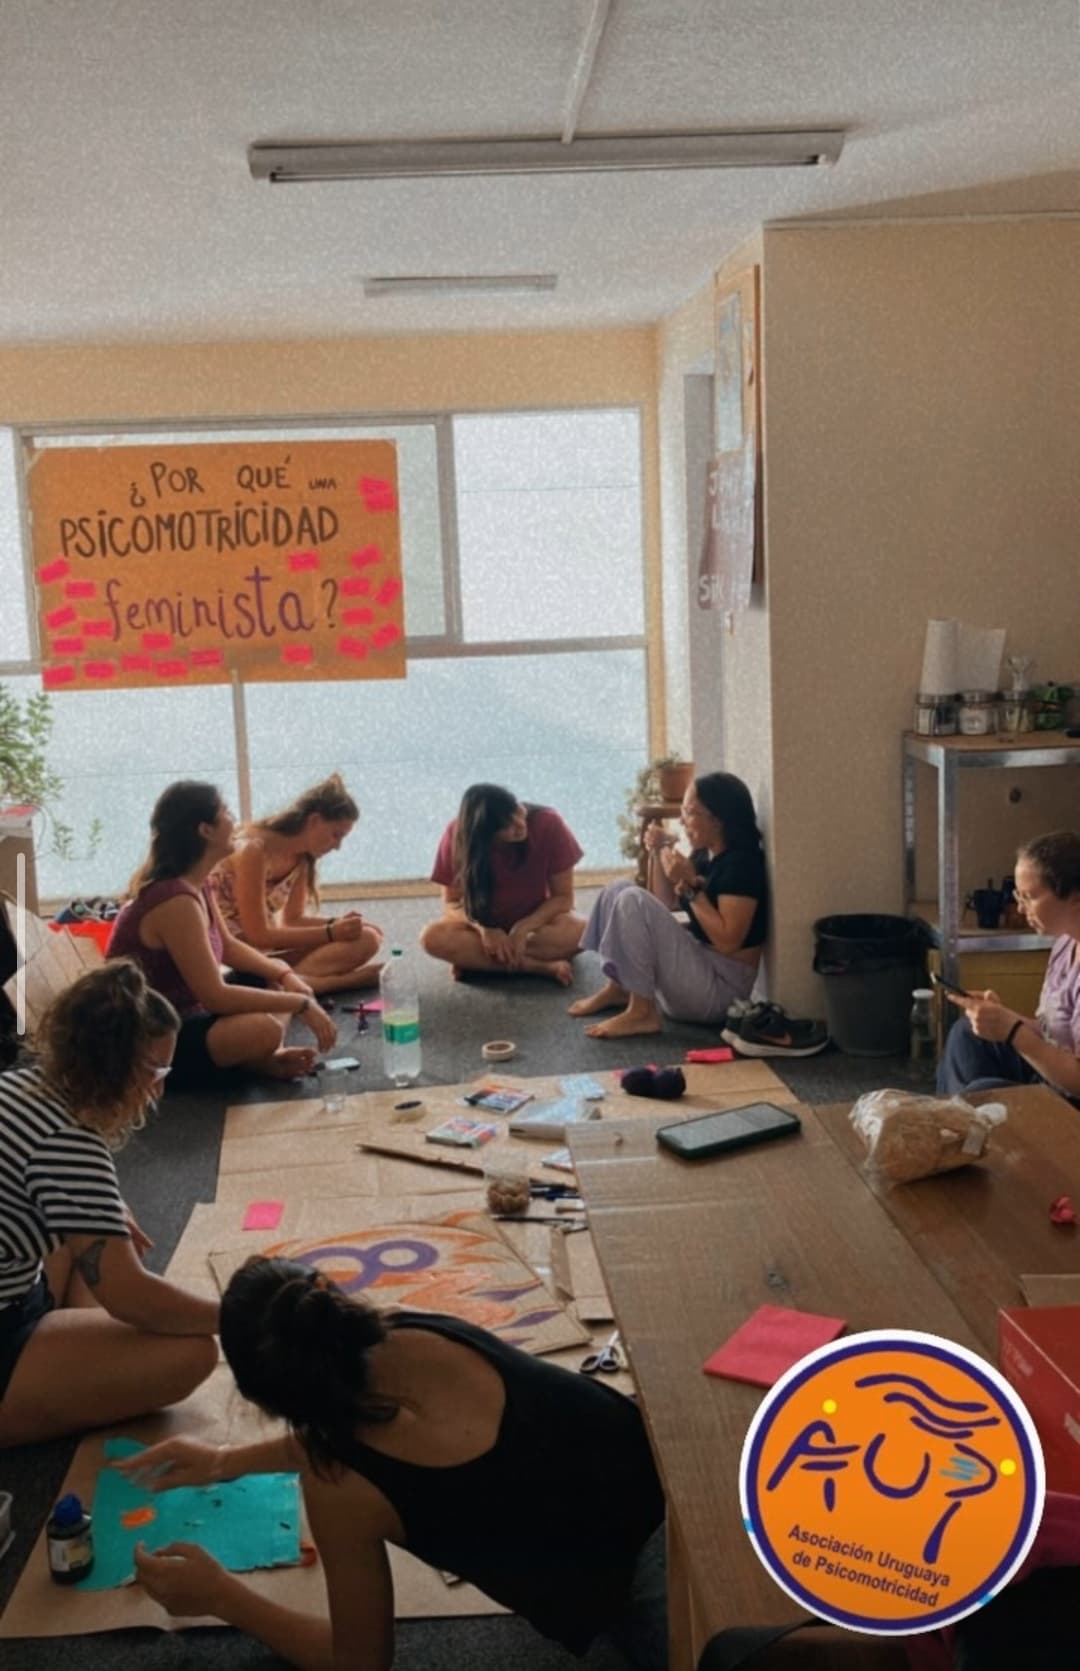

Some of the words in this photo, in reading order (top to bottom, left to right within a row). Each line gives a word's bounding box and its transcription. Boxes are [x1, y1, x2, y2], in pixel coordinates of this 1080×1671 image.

[129, 461, 205, 508] ¿POR
[237, 455, 291, 492] QUÉ
[60, 501, 339, 558] PSICOMOTRICIDAD
